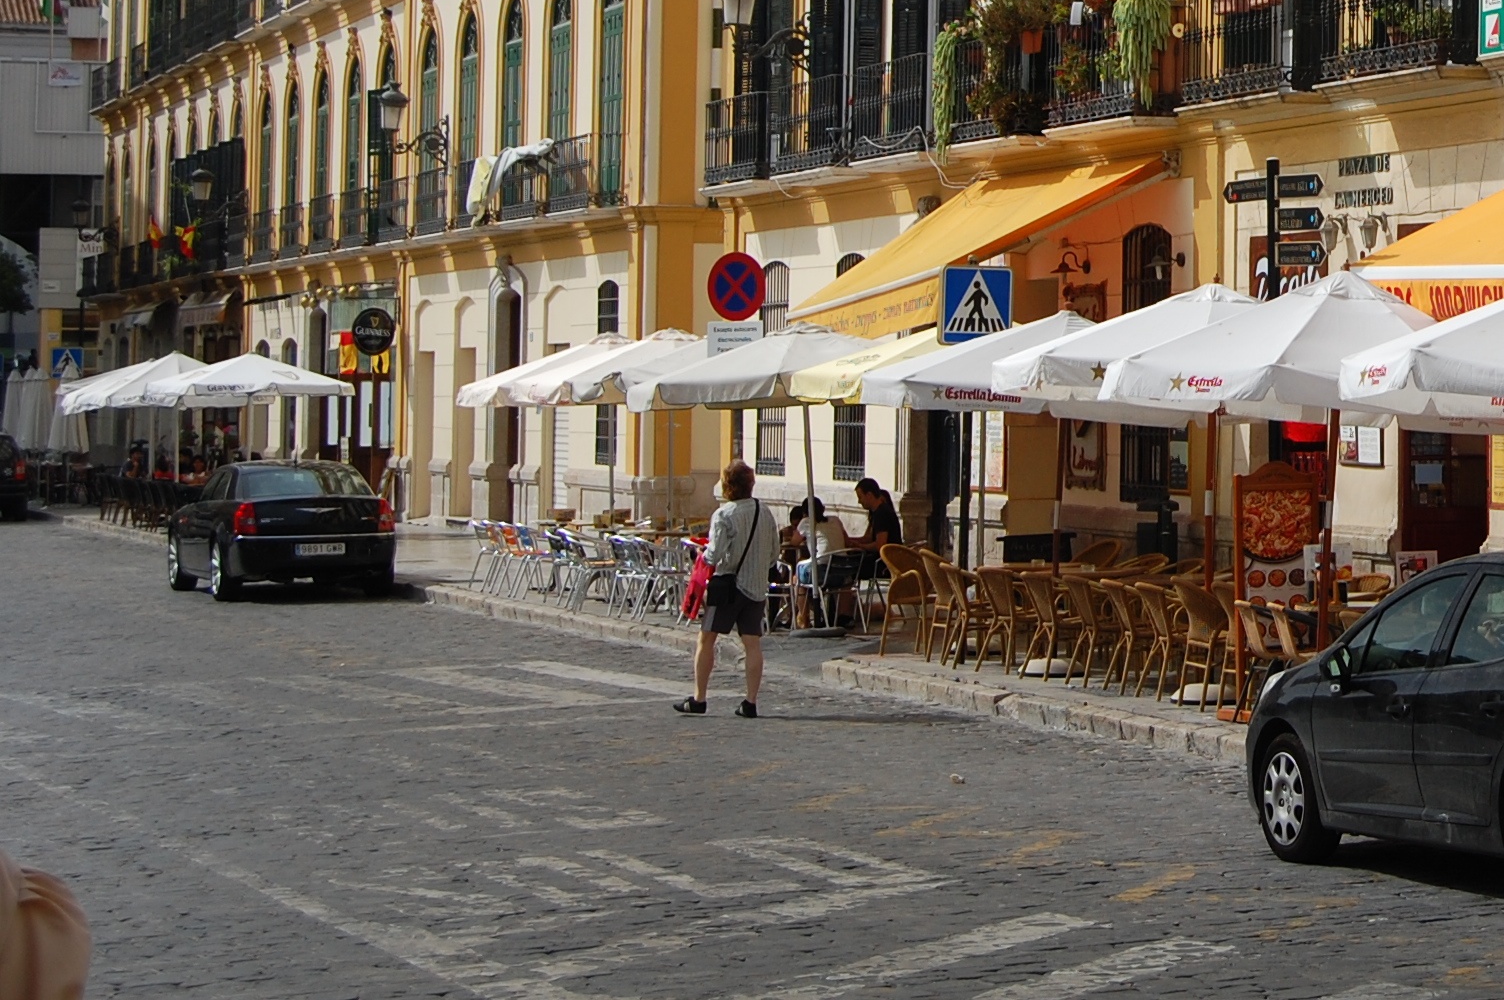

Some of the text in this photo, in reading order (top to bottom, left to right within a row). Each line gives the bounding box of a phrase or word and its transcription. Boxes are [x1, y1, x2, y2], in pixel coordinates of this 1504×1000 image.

[1338, 153, 1390, 178] PLAZA DE
[1334, 187, 1393, 209] LA MERCED
[355, 326, 391, 338] GUINNESS
[945, 386, 987, 400] Estrella
